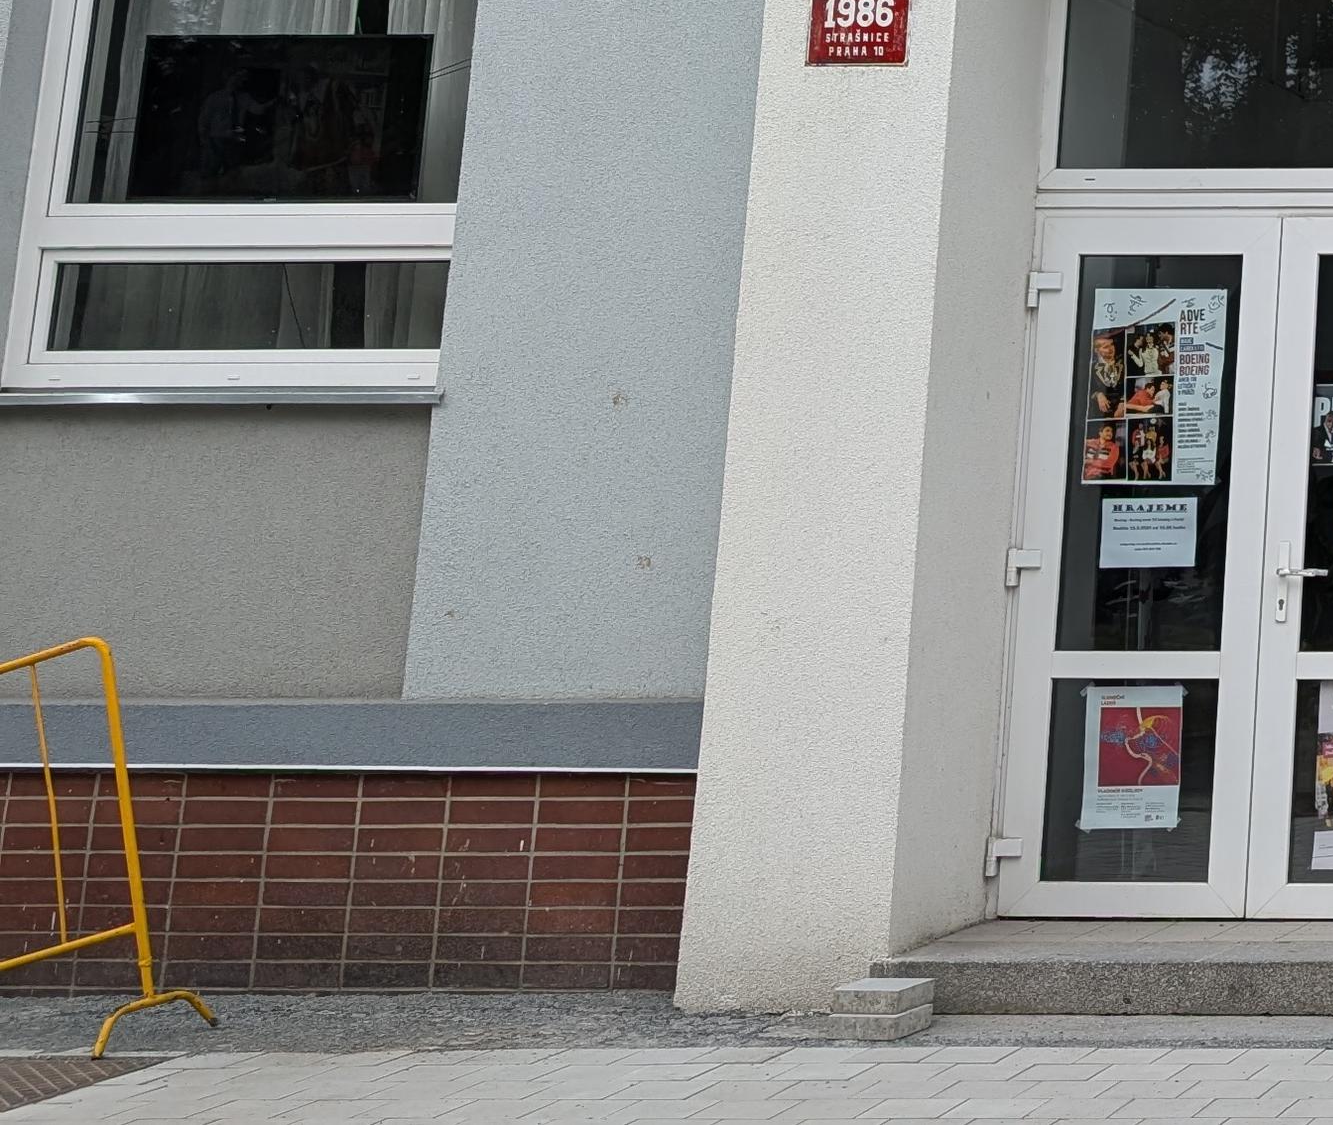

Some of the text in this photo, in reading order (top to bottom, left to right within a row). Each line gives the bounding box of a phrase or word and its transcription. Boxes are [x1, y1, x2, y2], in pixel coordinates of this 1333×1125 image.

[825, 29, 890, 43] STRAŠNICE
[828, 46, 884, 57] PRAHA 10
[1180, 309, 1206, 322] ADVE
[1180, 322, 1199, 335] RTE
[1180, 353, 1210, 364] BOEING
[1179, 365, 1209, 376] BOEING
[1112, 504, 1188, 513] HRAJEME
